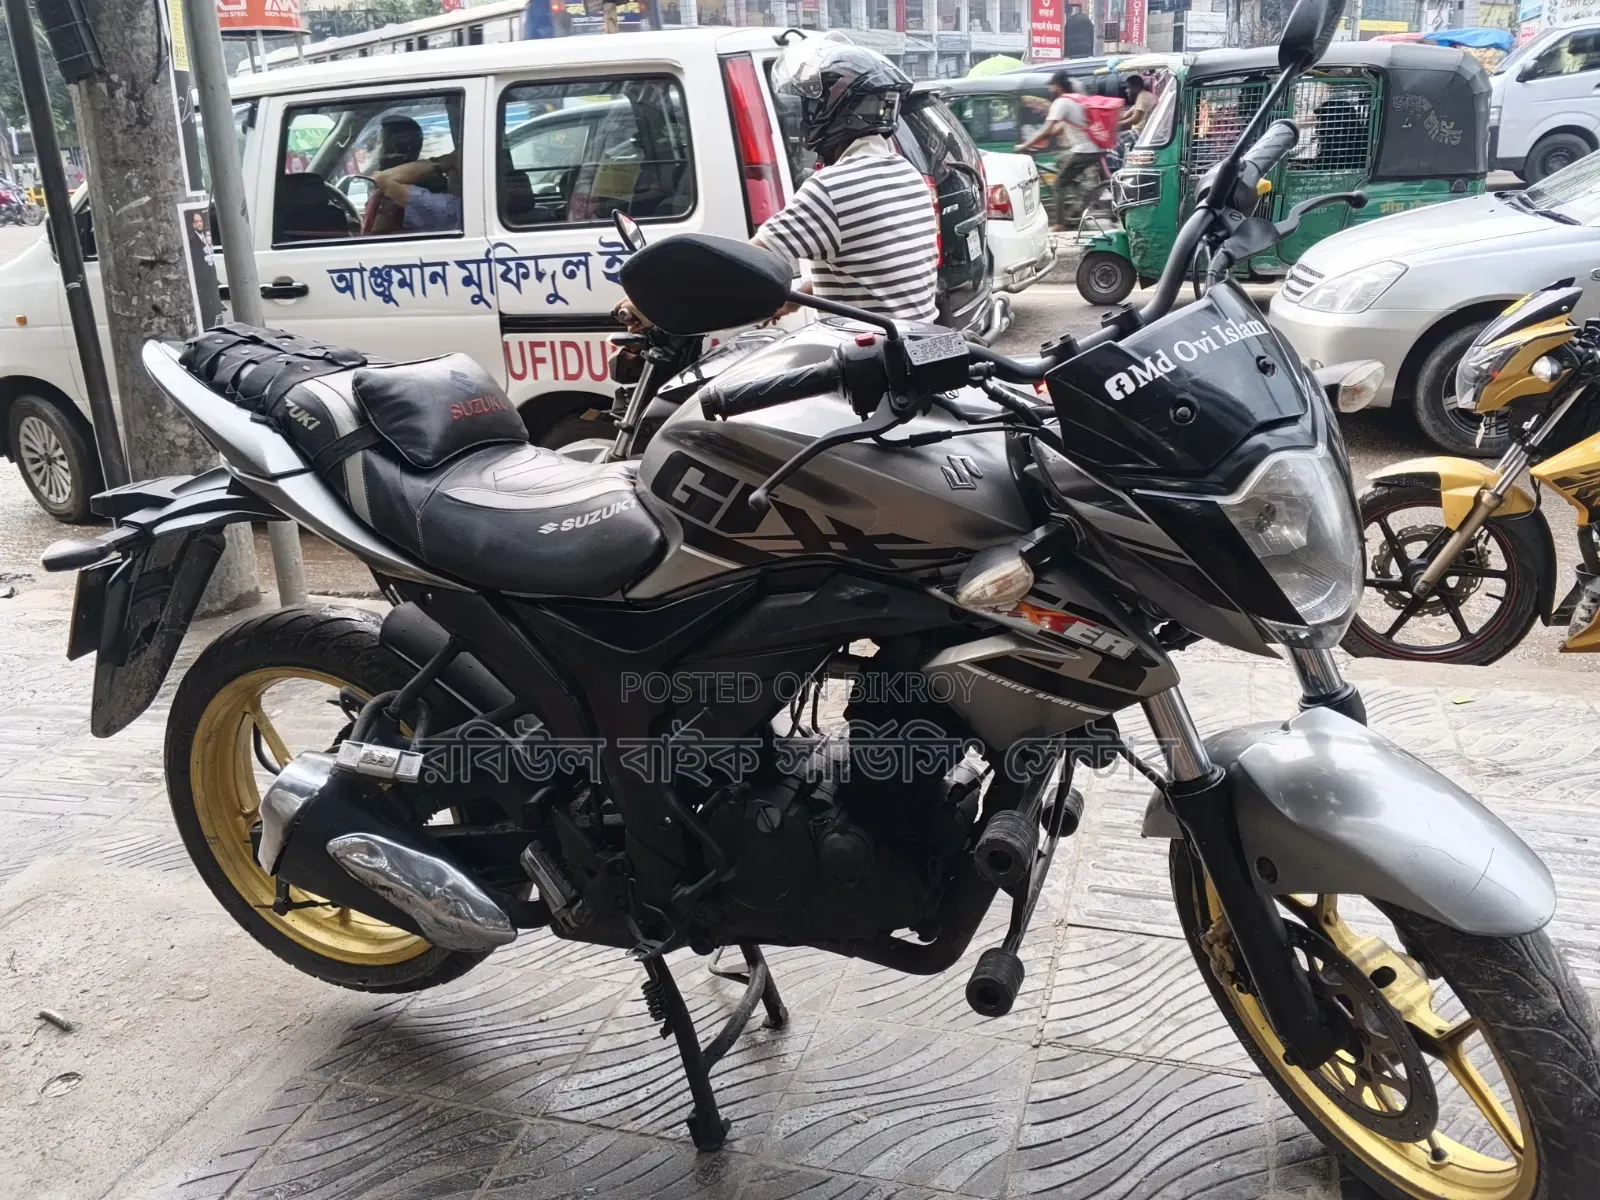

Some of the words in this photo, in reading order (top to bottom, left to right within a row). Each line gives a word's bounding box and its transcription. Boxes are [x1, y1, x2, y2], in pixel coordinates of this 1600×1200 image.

[1132, 0, 1142, 46] OTHERS
[326, 257, 450, 308] আঞ্জুমান
[503, 341, 617, 382] UFIDU
[1127, 349, 1178, 388] Md
[1173, 329, 1221, 362] Ovi
[1211, 317, 1270, 346] Islam
[283, 396, 321, 430] ZUKI
[449, 395, 509, 420] SUZUKI
[561, 500, 637, 532] SUZUKI
[986, 675, 1032, 695] STREET
[1035, 692, 1079, 711] SPORT
